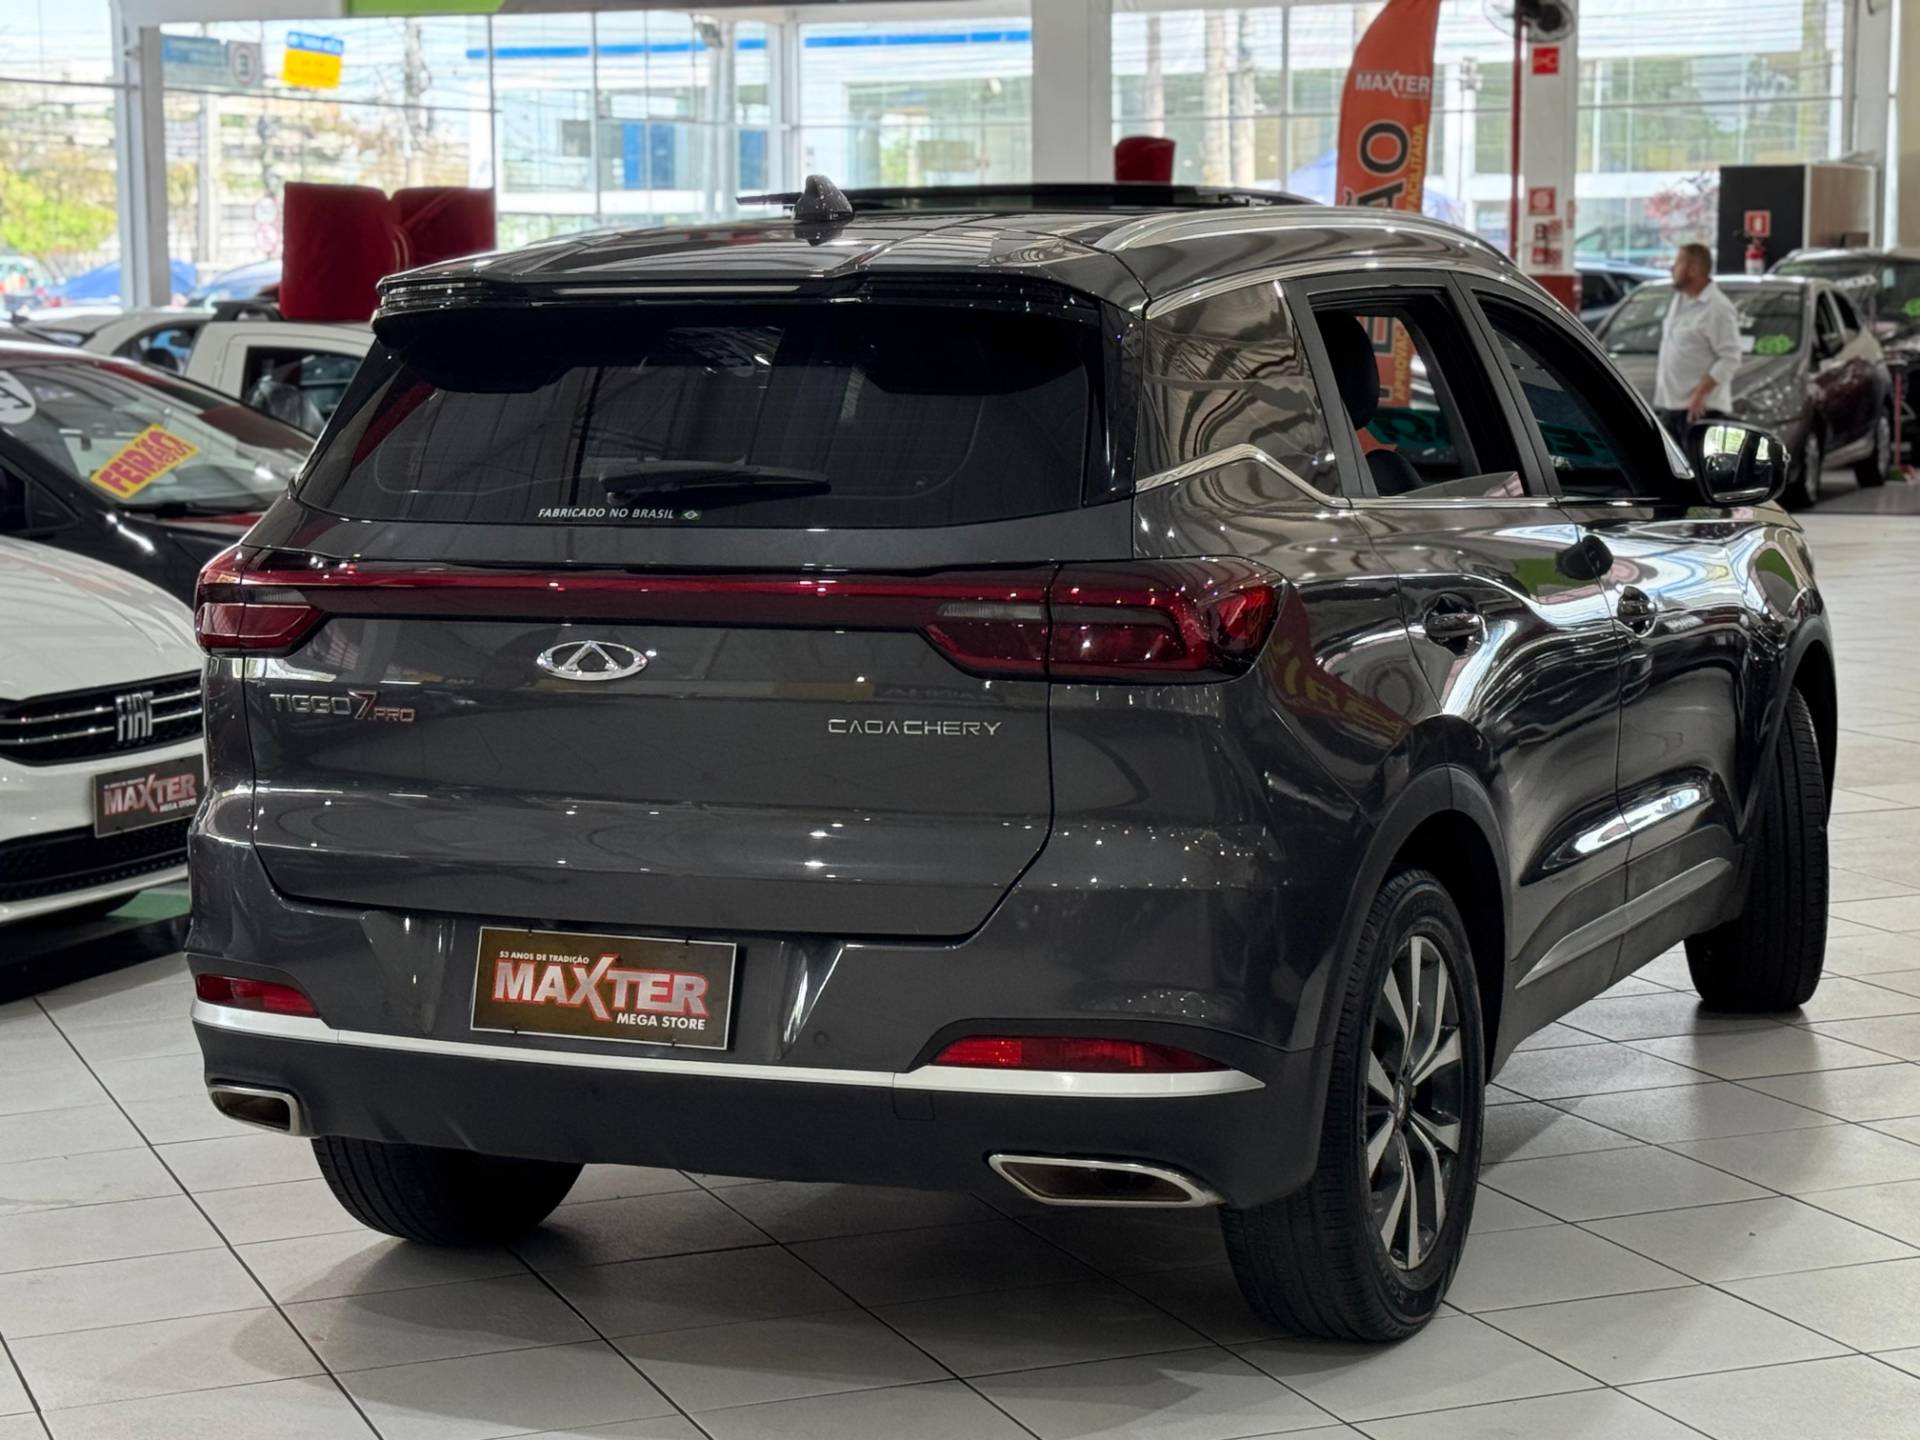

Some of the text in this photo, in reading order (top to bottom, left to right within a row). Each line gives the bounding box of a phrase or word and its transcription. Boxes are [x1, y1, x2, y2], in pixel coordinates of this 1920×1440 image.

[1355, 70, 1431, 98] MAXTER
[538, 508, 674, 519] FABRICADO NO BRASIL
[115, 690, 154, 742] FIAT
[269, 693, 350, 715] TIGGO
[103, 773, 198, 815] MAXTER
[511, 951, 534, 960] ANOS
[536, 953, 547, 961] DE
[492, 954, 709, 1022] MAXTER
[617, 1012, 706, 1031] MEGA STORE
